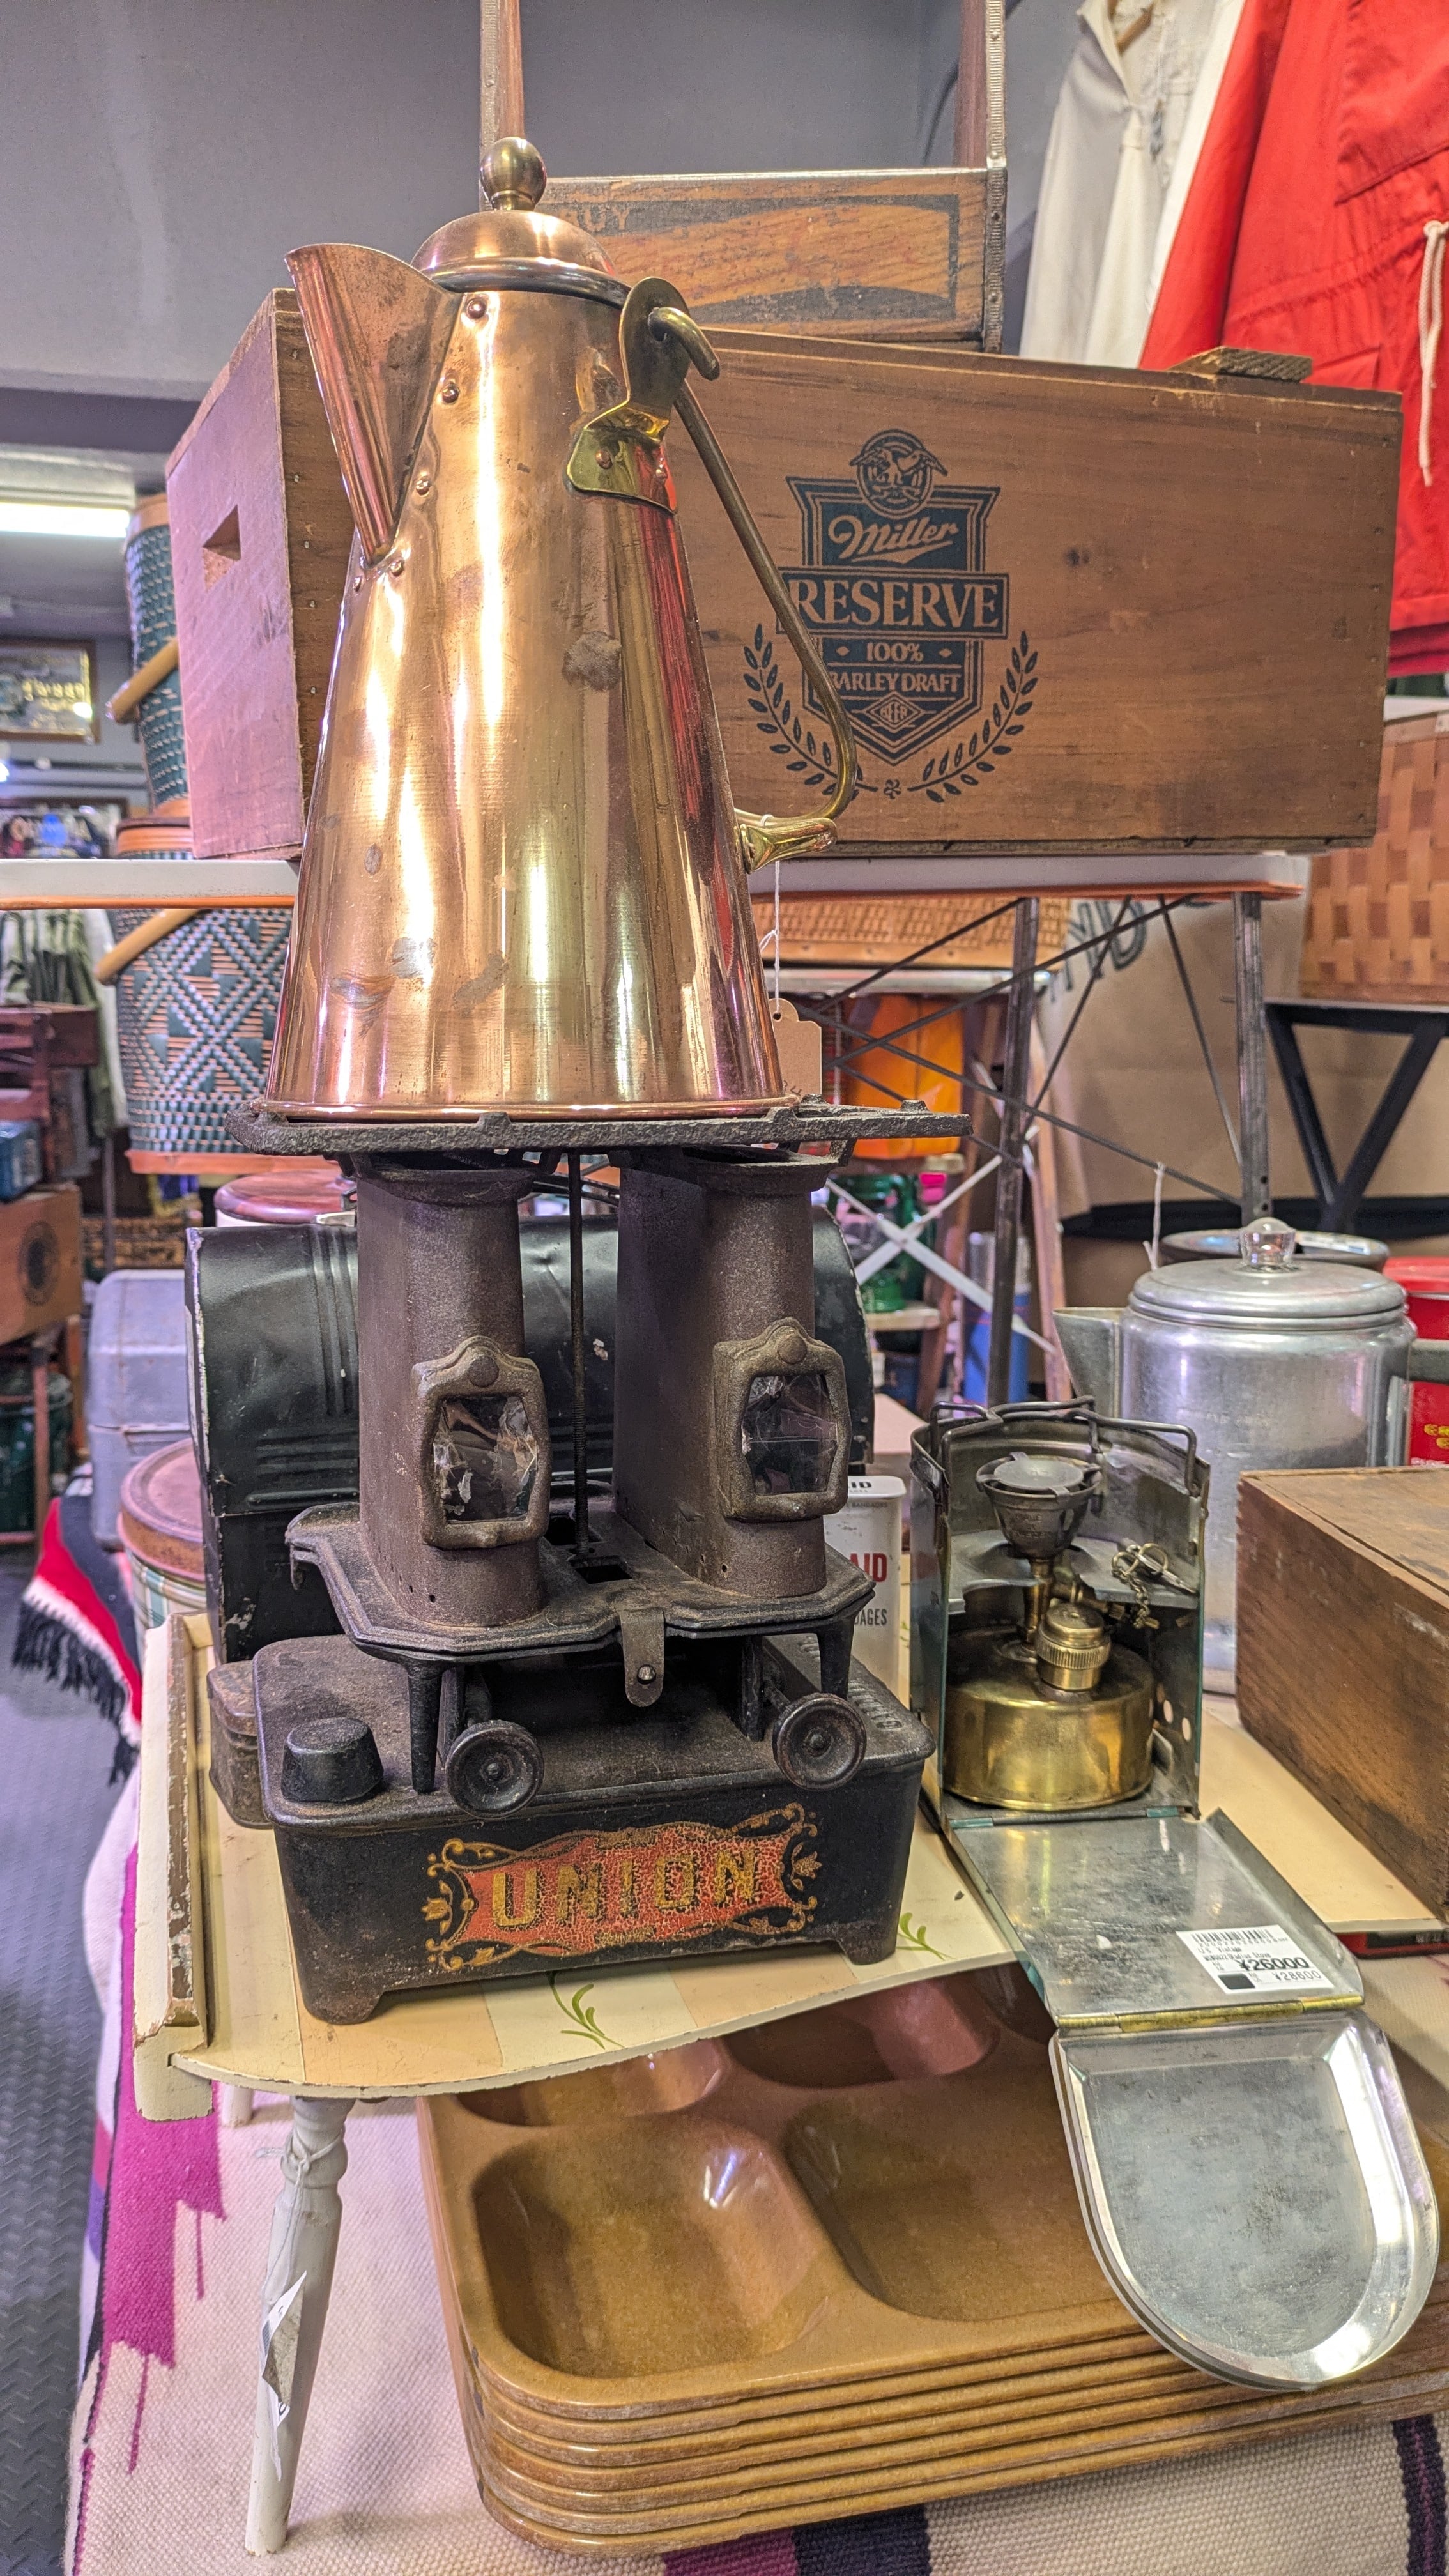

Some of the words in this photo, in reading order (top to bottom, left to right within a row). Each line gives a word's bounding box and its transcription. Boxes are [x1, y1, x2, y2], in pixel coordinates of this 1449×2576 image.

[828, 514, 958, 560] Miller
[788, 579, 999, 628] RESERVE
[866, 642, 924, 662] 100%
[901, 673, 962, 693] DRAFT
[492, 1850, 758, 1930] UNION
[1235, 1957, 1310, 1972] ¥26000
[1271, 1970, 1322, 1981] ¥28600
